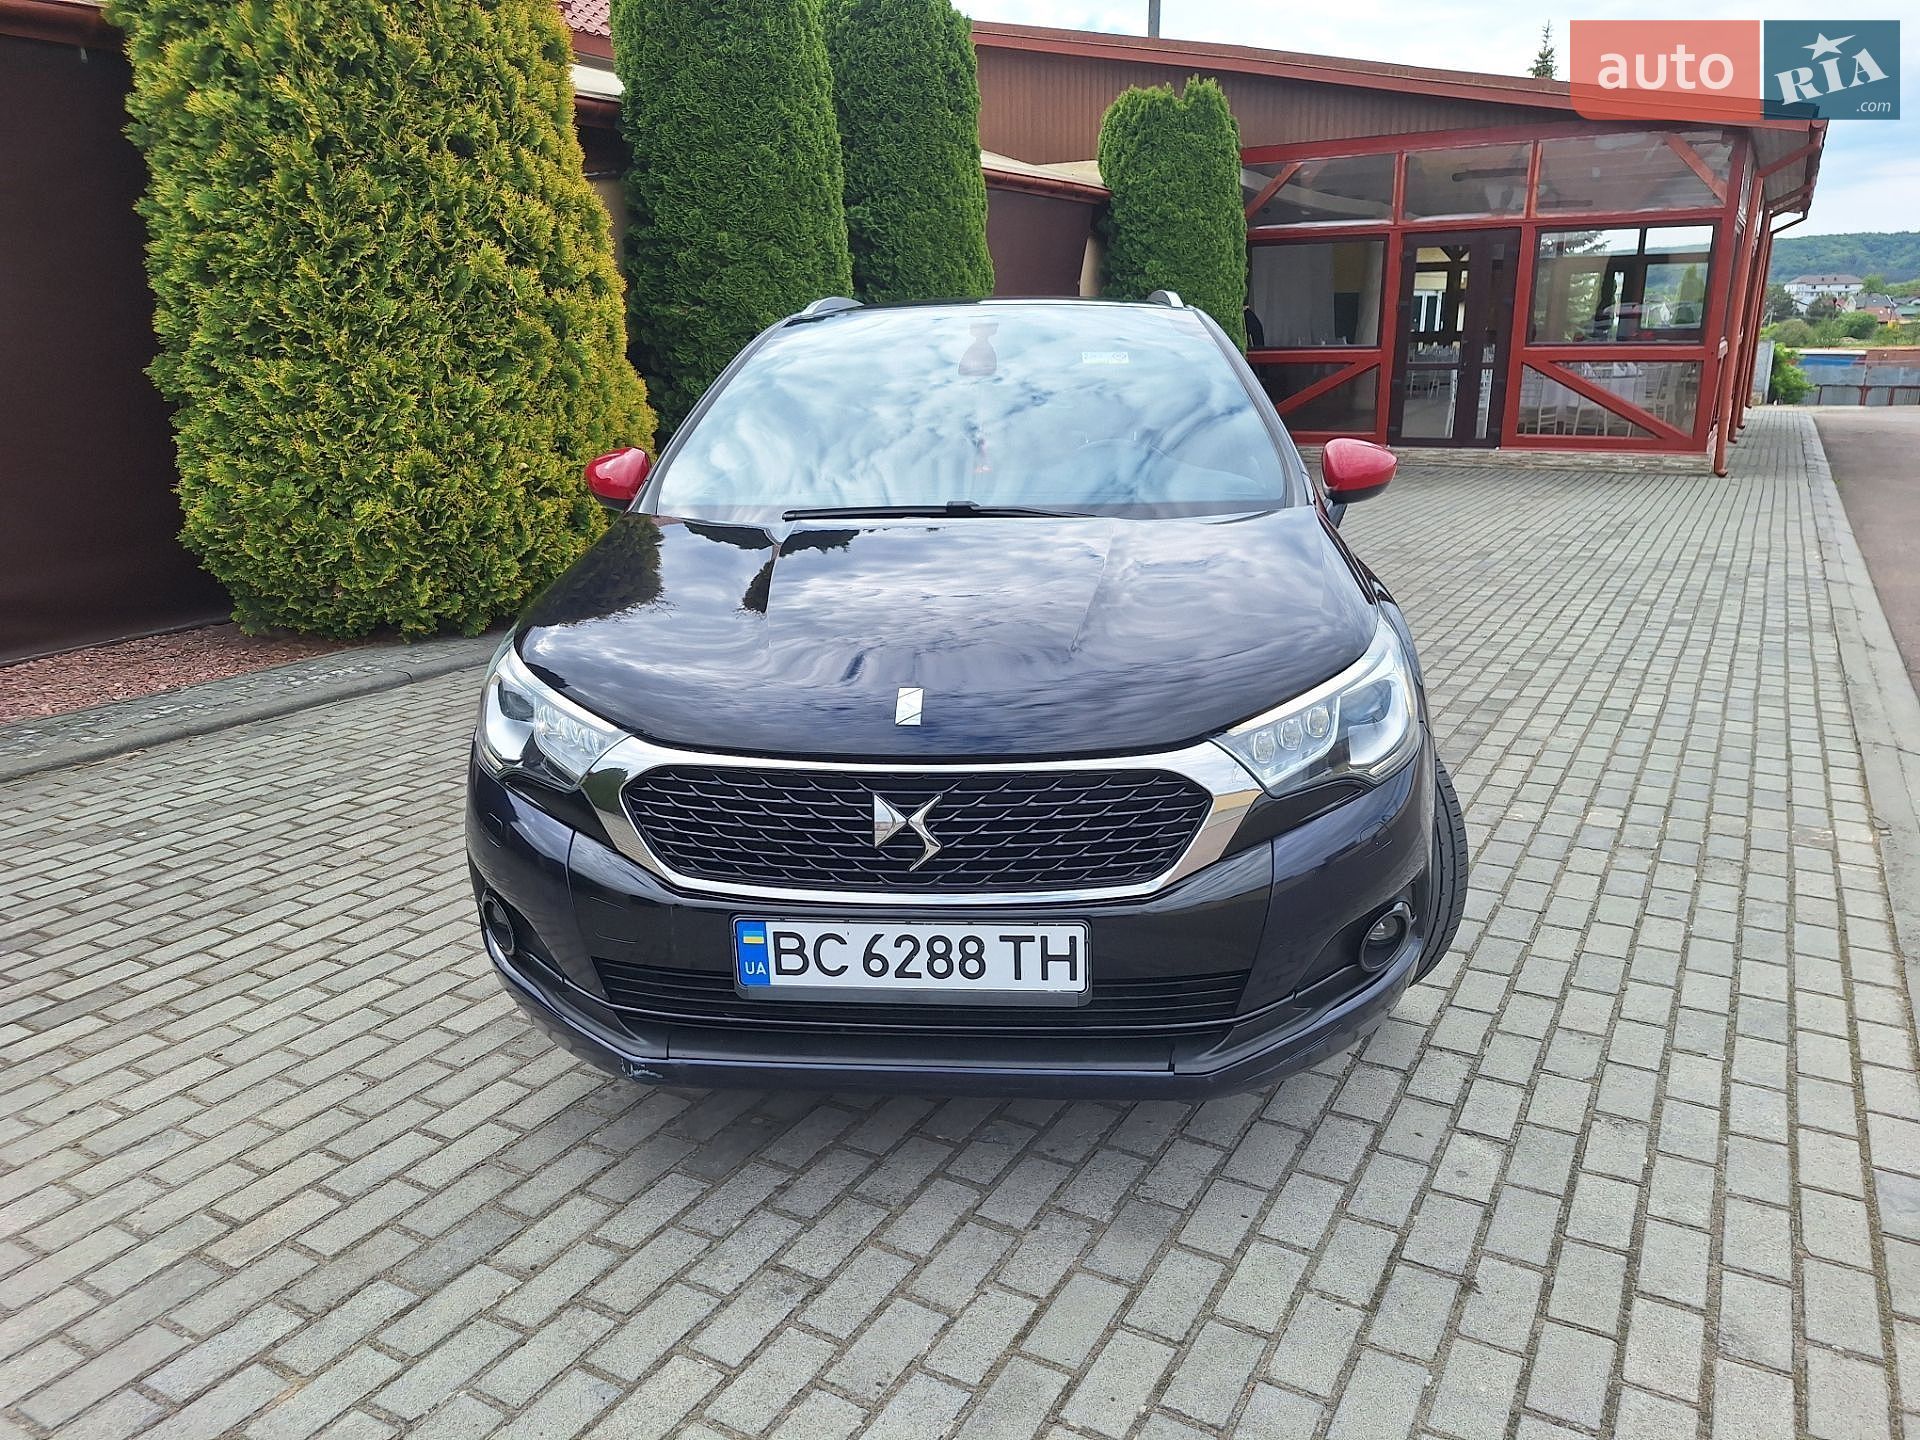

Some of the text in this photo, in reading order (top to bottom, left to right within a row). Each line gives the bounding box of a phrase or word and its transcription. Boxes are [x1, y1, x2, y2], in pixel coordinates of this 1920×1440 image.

[745, 961, 767, 976] UA
[772, 930, 1077, 981] BC 6288 TH
